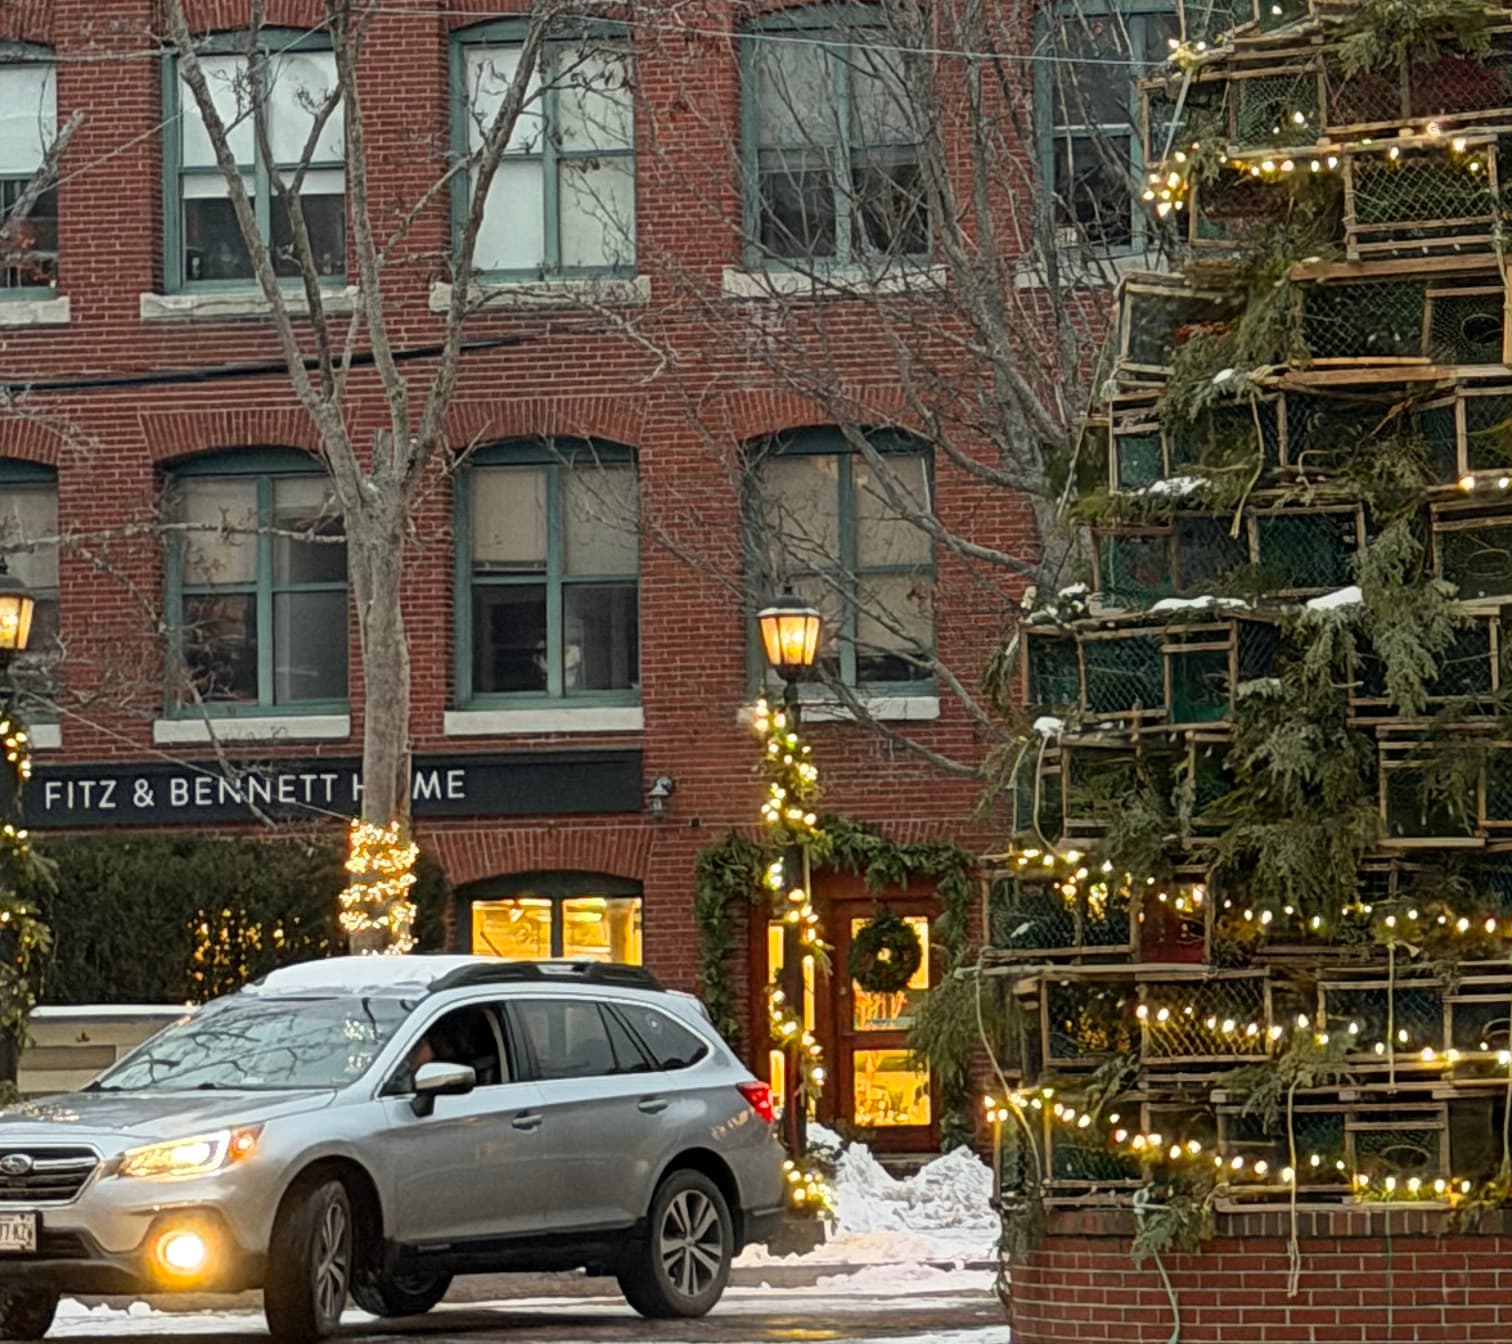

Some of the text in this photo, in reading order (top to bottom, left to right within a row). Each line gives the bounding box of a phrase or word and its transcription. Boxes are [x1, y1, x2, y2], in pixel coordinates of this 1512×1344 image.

[45, 769, 466, 810] FITZ & BENNETT HME
